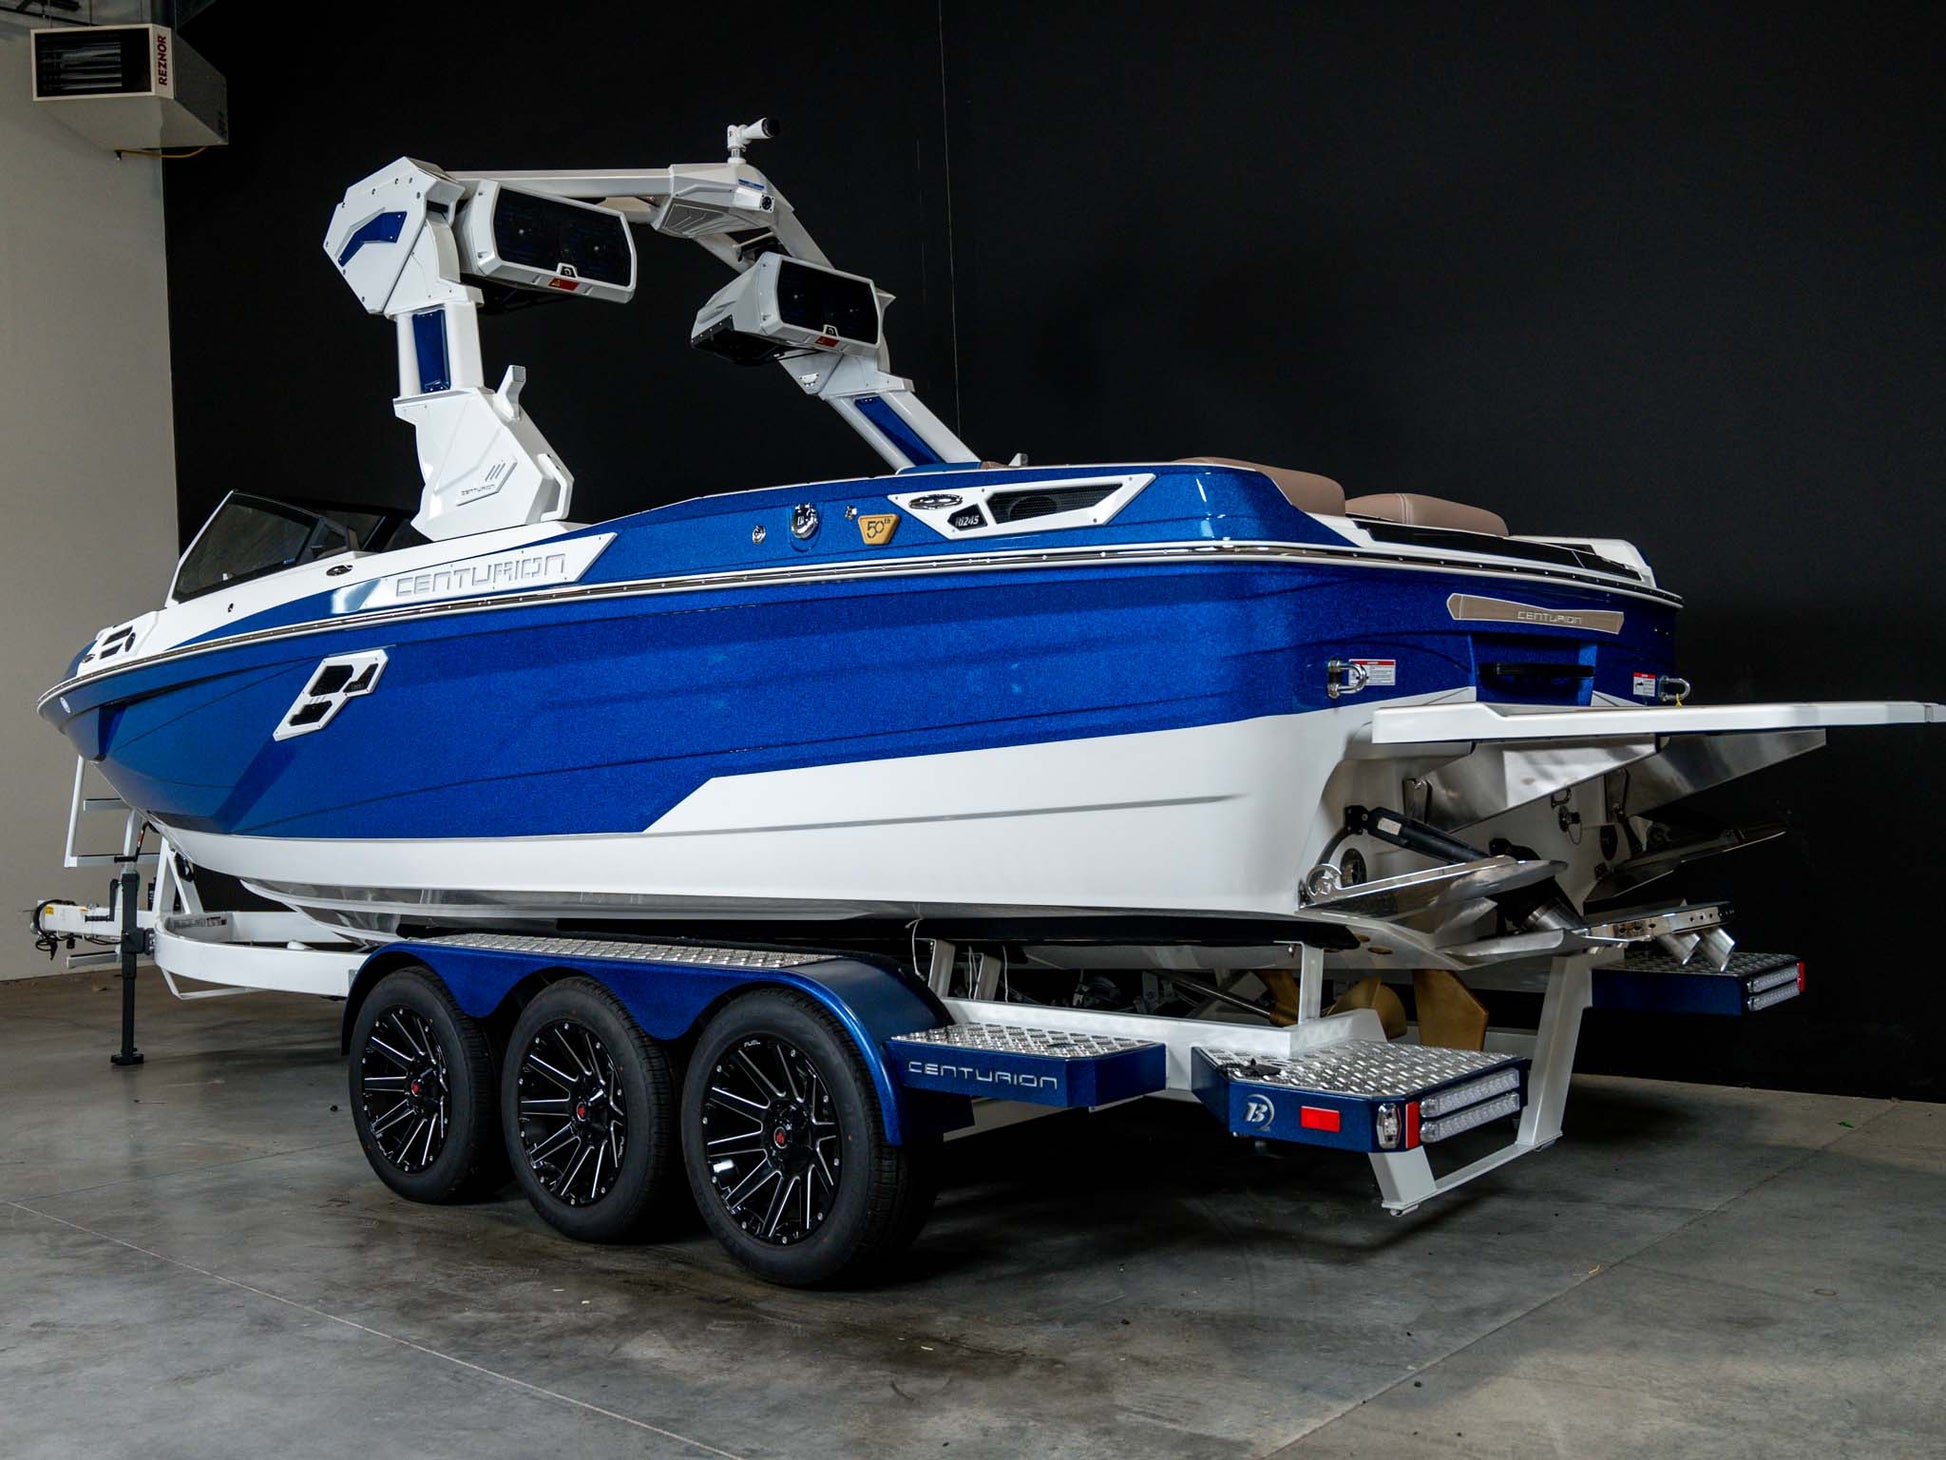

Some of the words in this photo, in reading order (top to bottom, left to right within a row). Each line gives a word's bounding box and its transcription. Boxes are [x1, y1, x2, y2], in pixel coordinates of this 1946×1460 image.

[157, 35, 168, 86] REZNOR
[396, 553, 566, 598] CENTURION
[1517, 610, 1582, 625] CENTURION
[908, 1061, 1058, 1090] CENTURION
